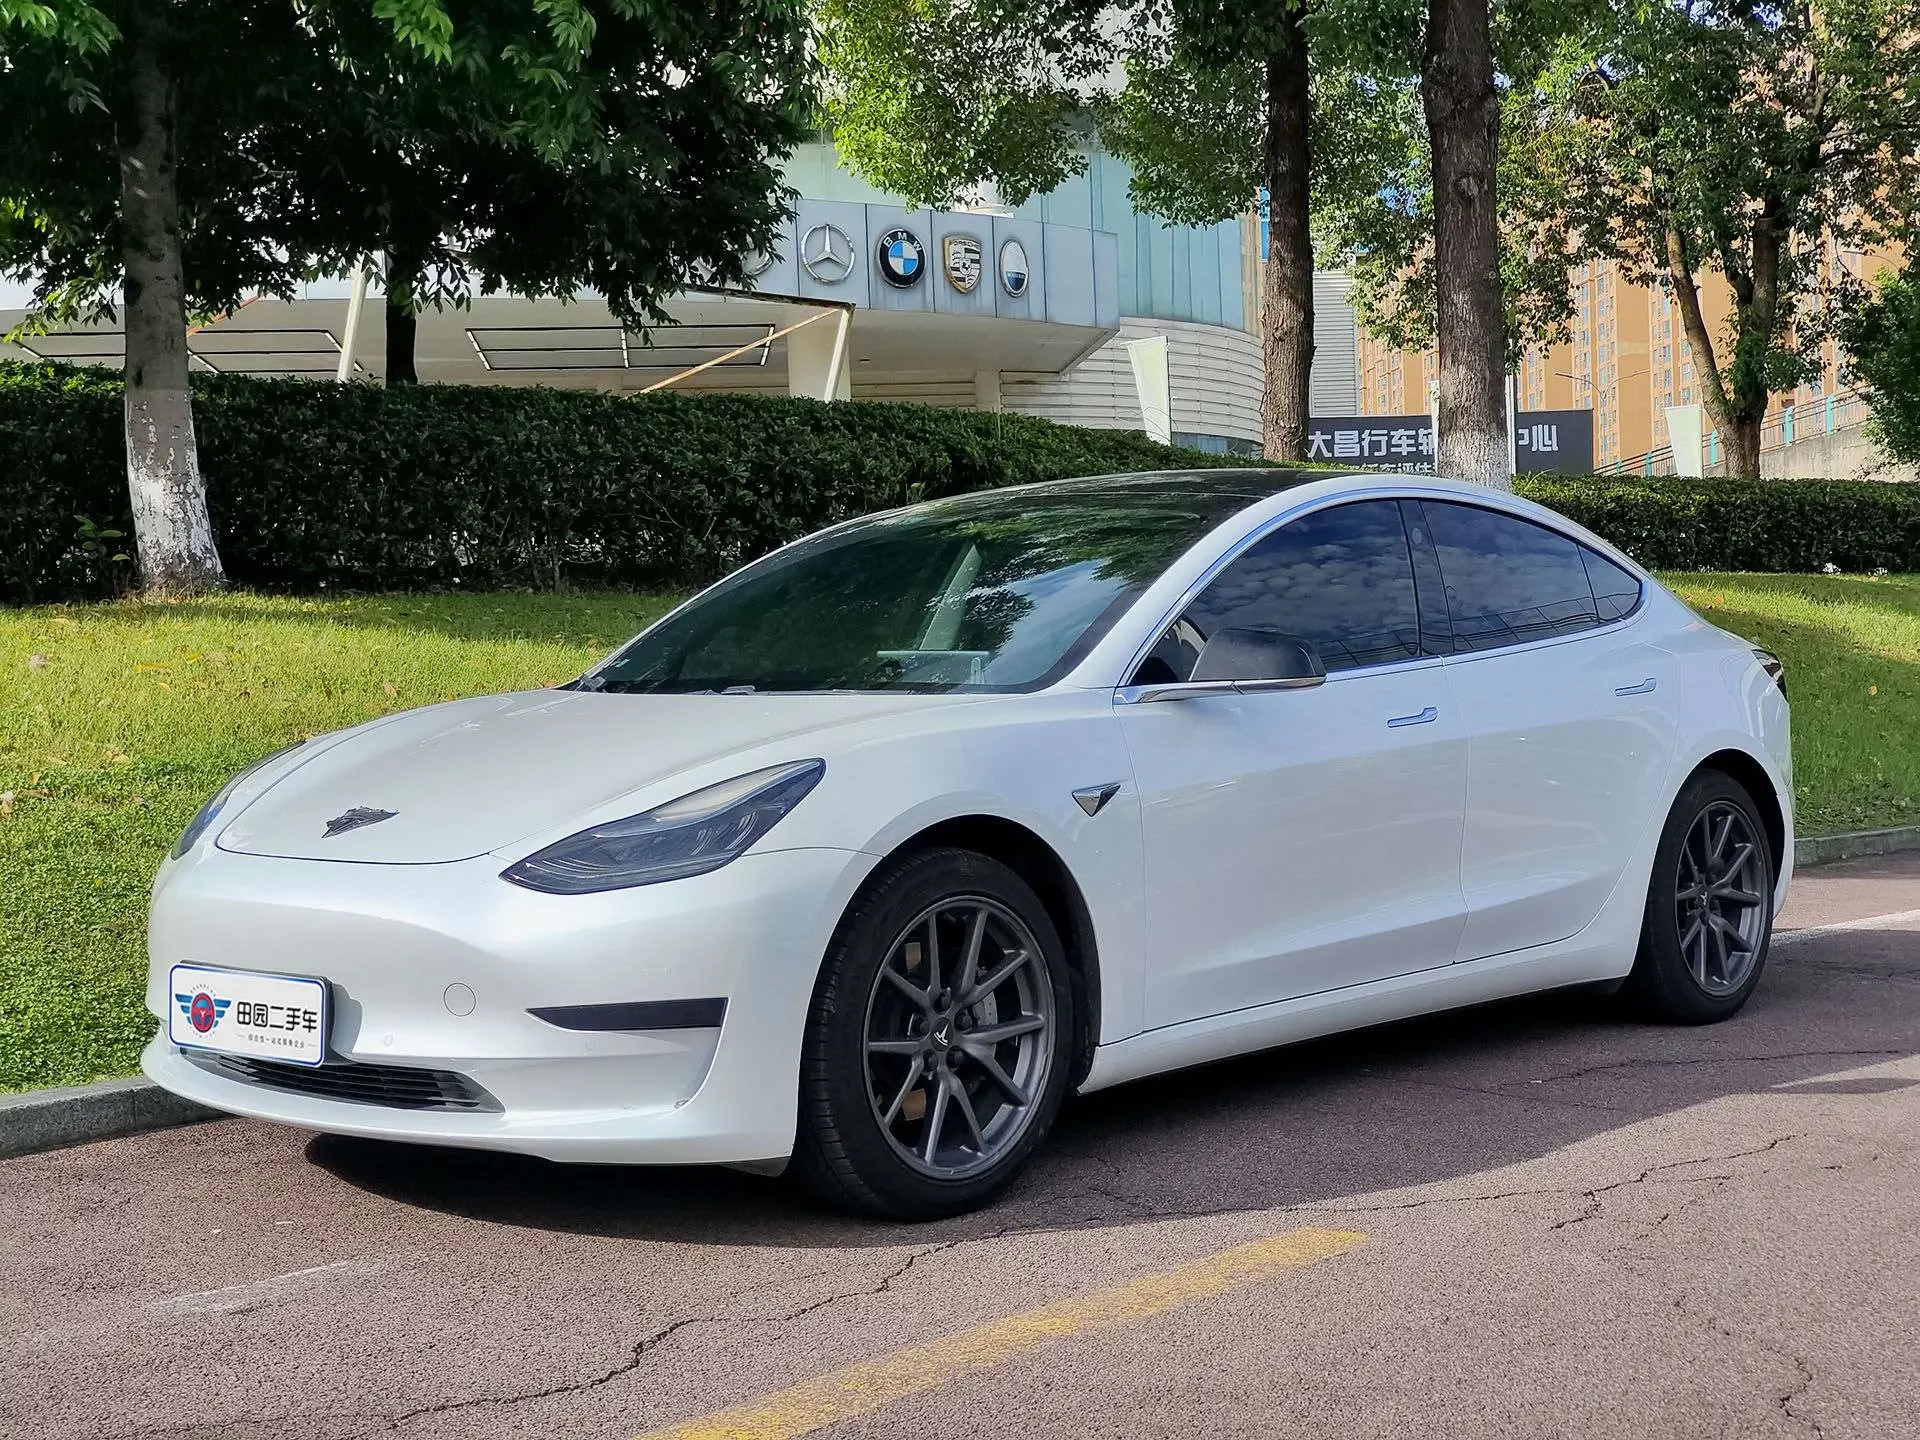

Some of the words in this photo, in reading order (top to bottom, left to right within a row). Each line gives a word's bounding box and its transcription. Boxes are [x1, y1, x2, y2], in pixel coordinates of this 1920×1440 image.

[883, 232, 922, 251] BMW
[237, 1001, 317, 1033] 田园二手车
